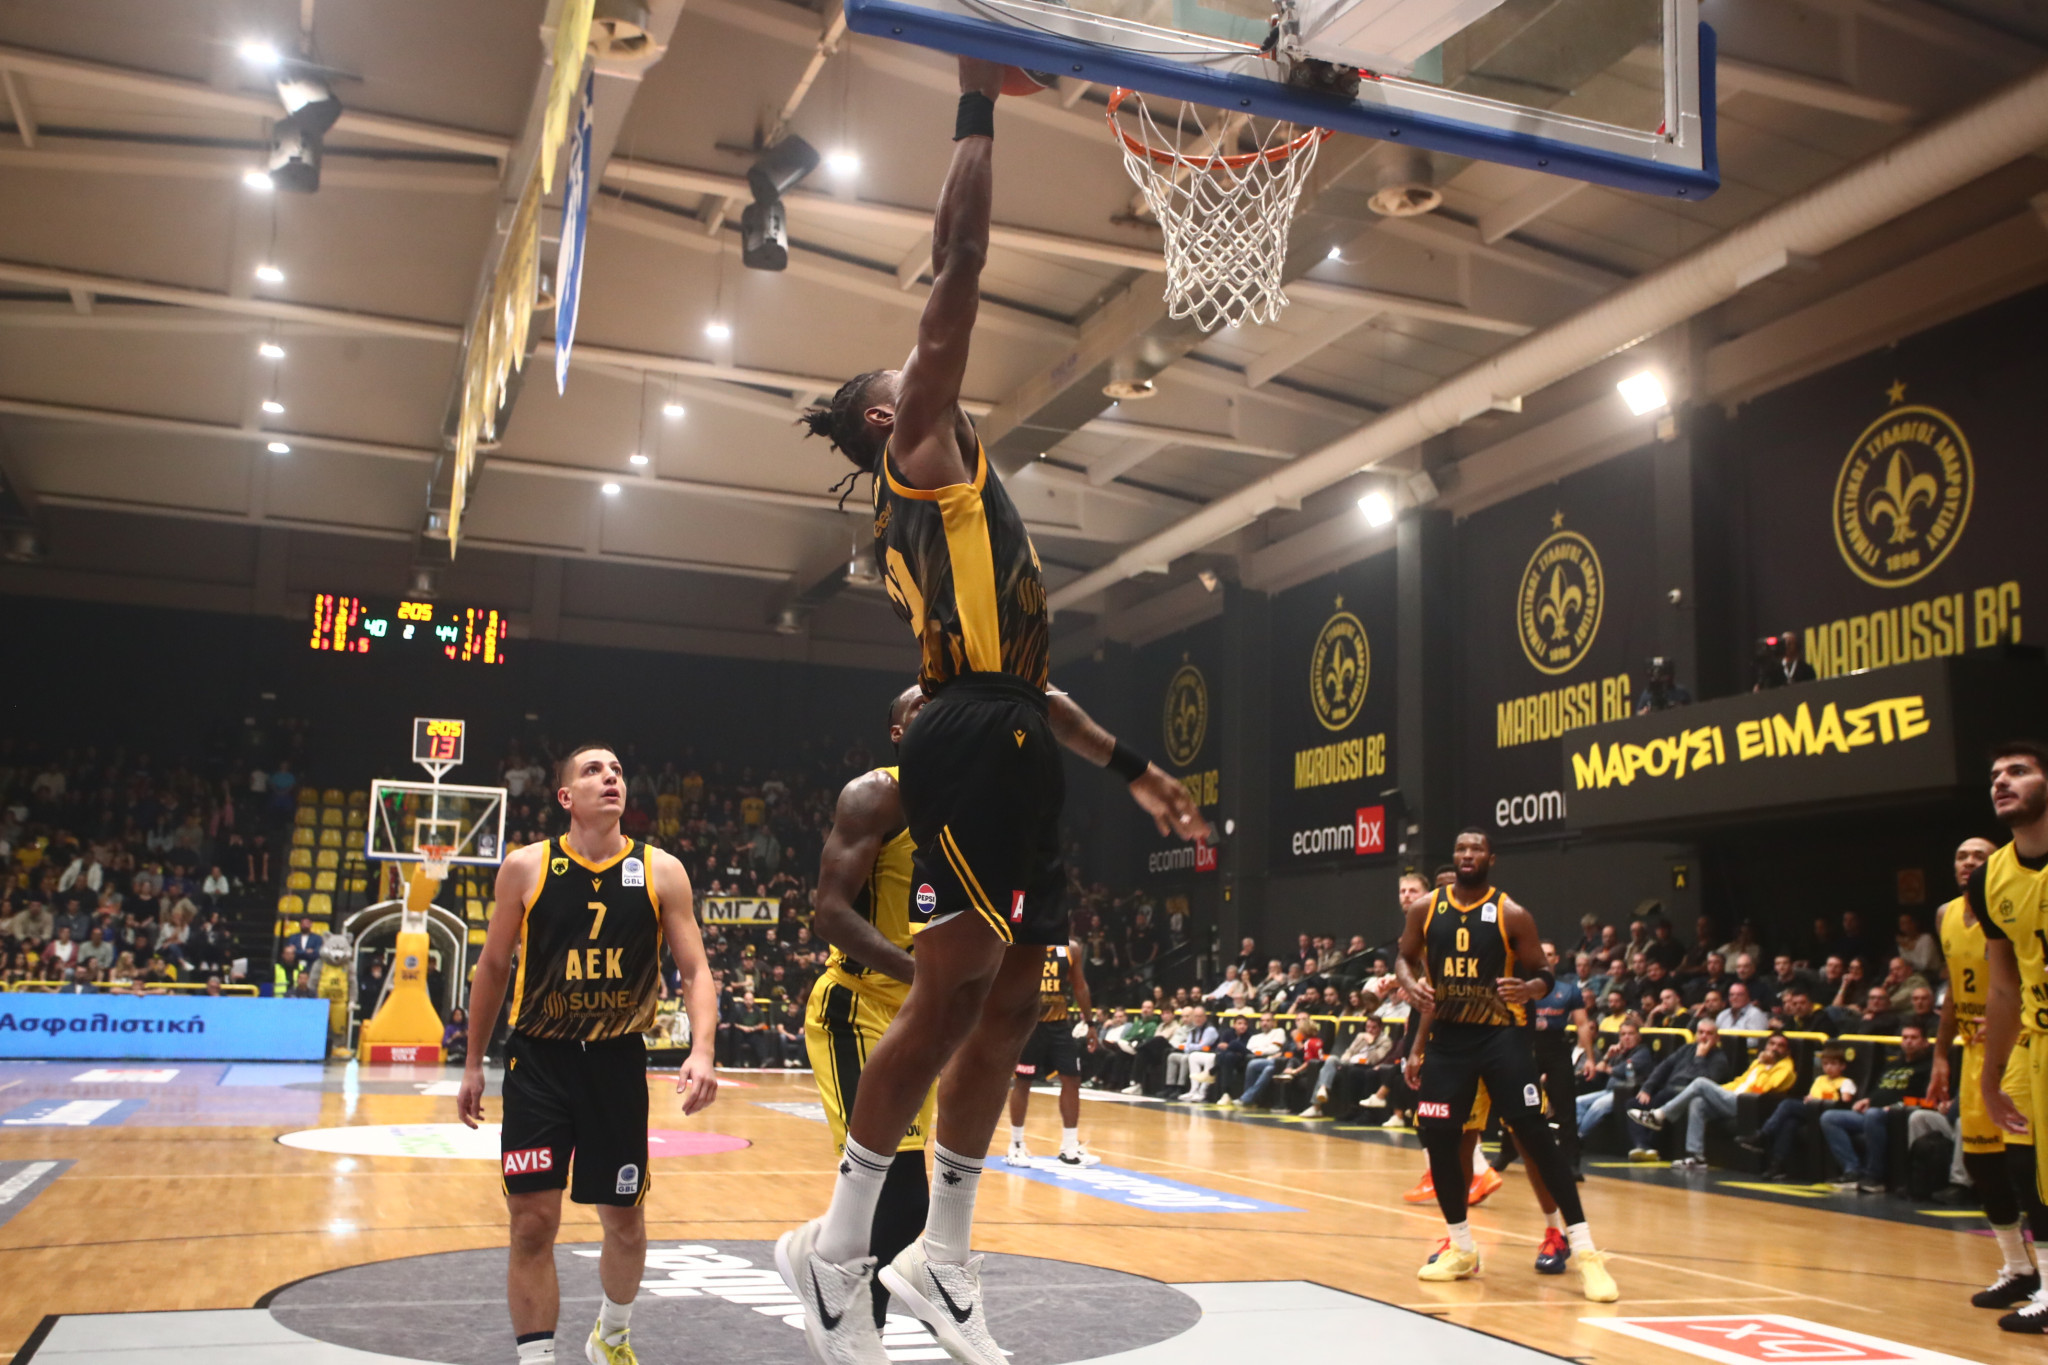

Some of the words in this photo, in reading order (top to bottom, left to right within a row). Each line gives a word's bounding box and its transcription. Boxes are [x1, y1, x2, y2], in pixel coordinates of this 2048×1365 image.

[364, 618, 387, 637] 40
[403, 624, 415, 639] 2
[436, 625, 458, 642] 44
[1805, 593, 1964, 681] MAROUSSI
[1974, 580, 2022, 648] BC
[1497, 682, 1597, 748] MAROUSSI
[1602, 673, 1631, 722] BC
[430, 736, 456, 759] 13
[1295, 739, 1363, 789] MAROUSSI
[1366, 733, 1386, 776] BC
[1496, 790, 1567, 827] ecom
[917, 893, 935, 903] PEPSI
[587, 901, 608, 940] 7
[1456, 927, 1470, 952] 0
[565, 947, 624, 981] AEK
[1042, 961, 1059, 977] 24
[1444, 957, 1479, 979] AEK
[1963, 968, 1976, 993] 2
[0, 1012, 206, 1036] Ασφαλιστική
[1418, 1102, 1449, 1117] AVIS
[504, 1149, 552, 1173] AVIS
